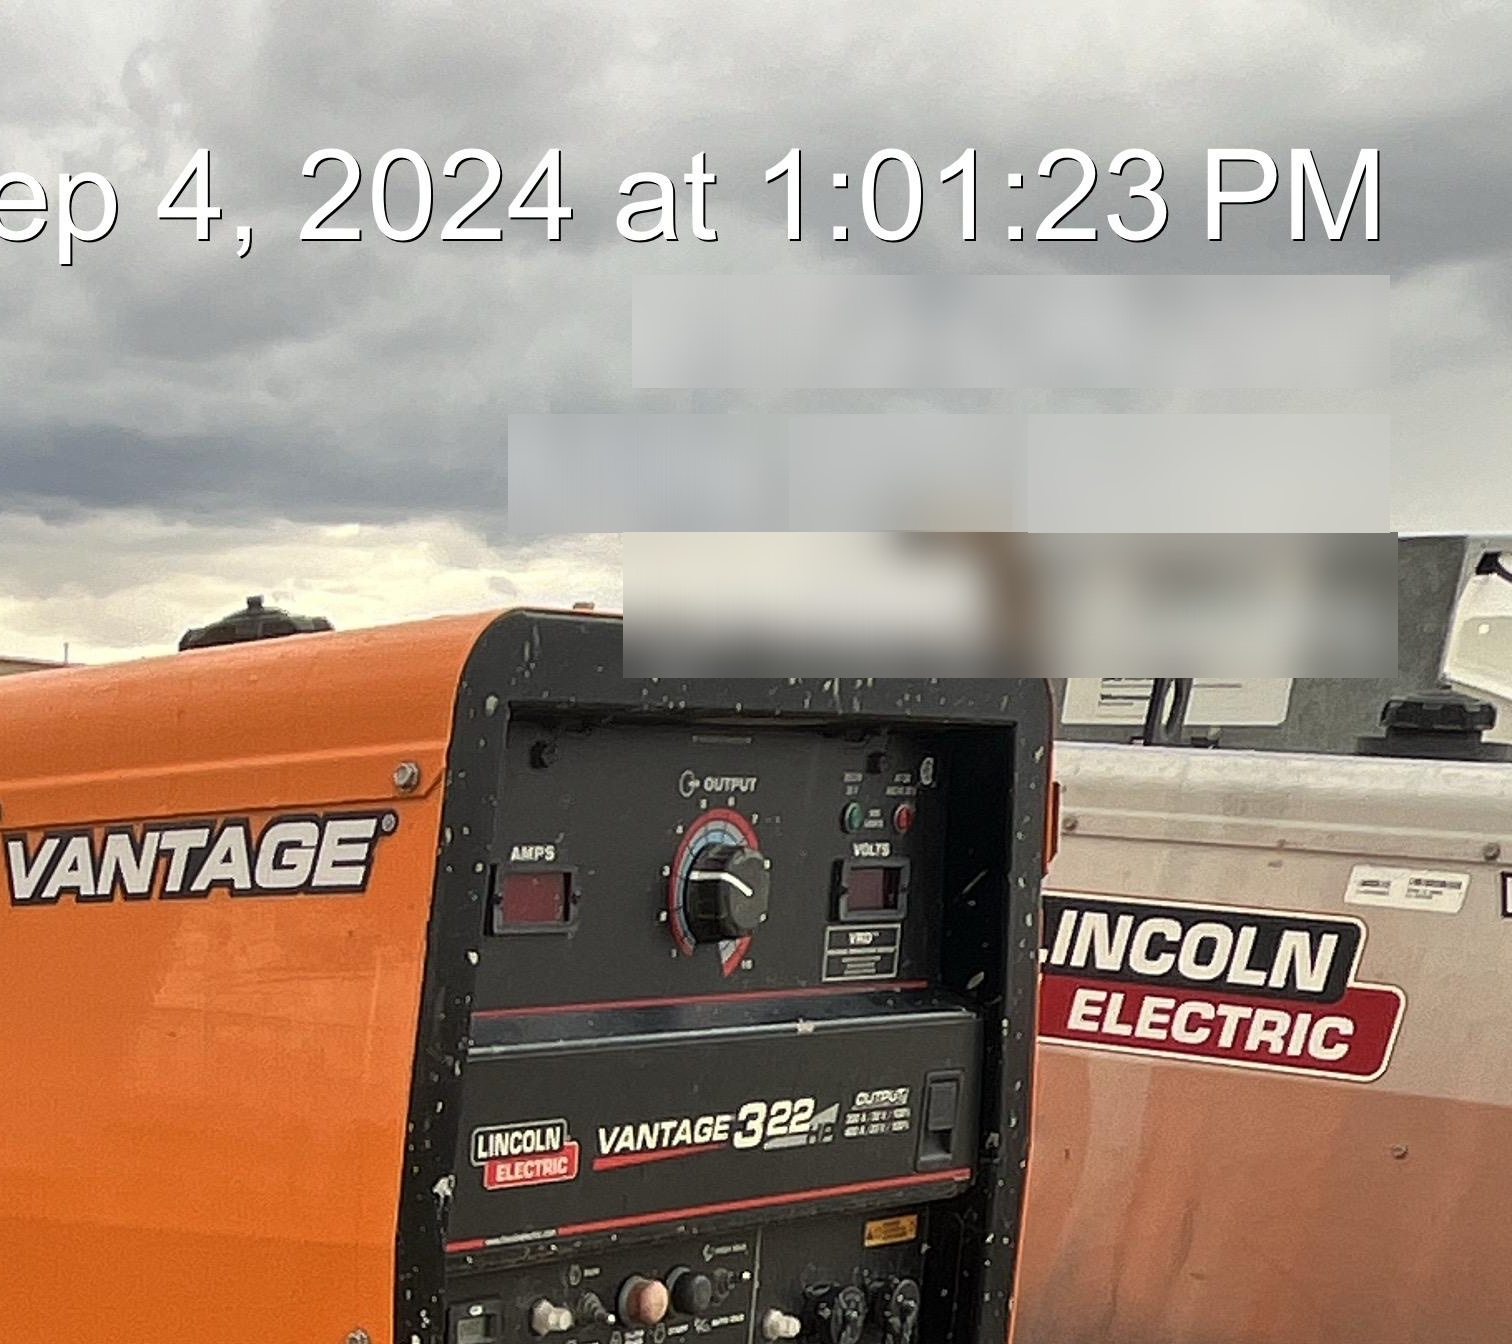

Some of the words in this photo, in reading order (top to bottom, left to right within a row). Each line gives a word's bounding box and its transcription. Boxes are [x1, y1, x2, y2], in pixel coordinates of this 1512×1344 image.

[703, 776, 758, 793] OUTPUT
[6, 817, 379, 900] VANTAGE
[510, 844, 556, 862] AMPS
[852, 841, 891, 857] VOLTS
[1038, 908, 1340, 993] INCOLN
[1066, 987, 1355, 1062] ELECTRIC
[477, 1125, 562, 1159] LINCOLN
[597, 1113, 732, 1155] VANTAGE
[732, 1096, 817, 1150] 322
[495, 1156, 569, 1183] ELECTRIC
